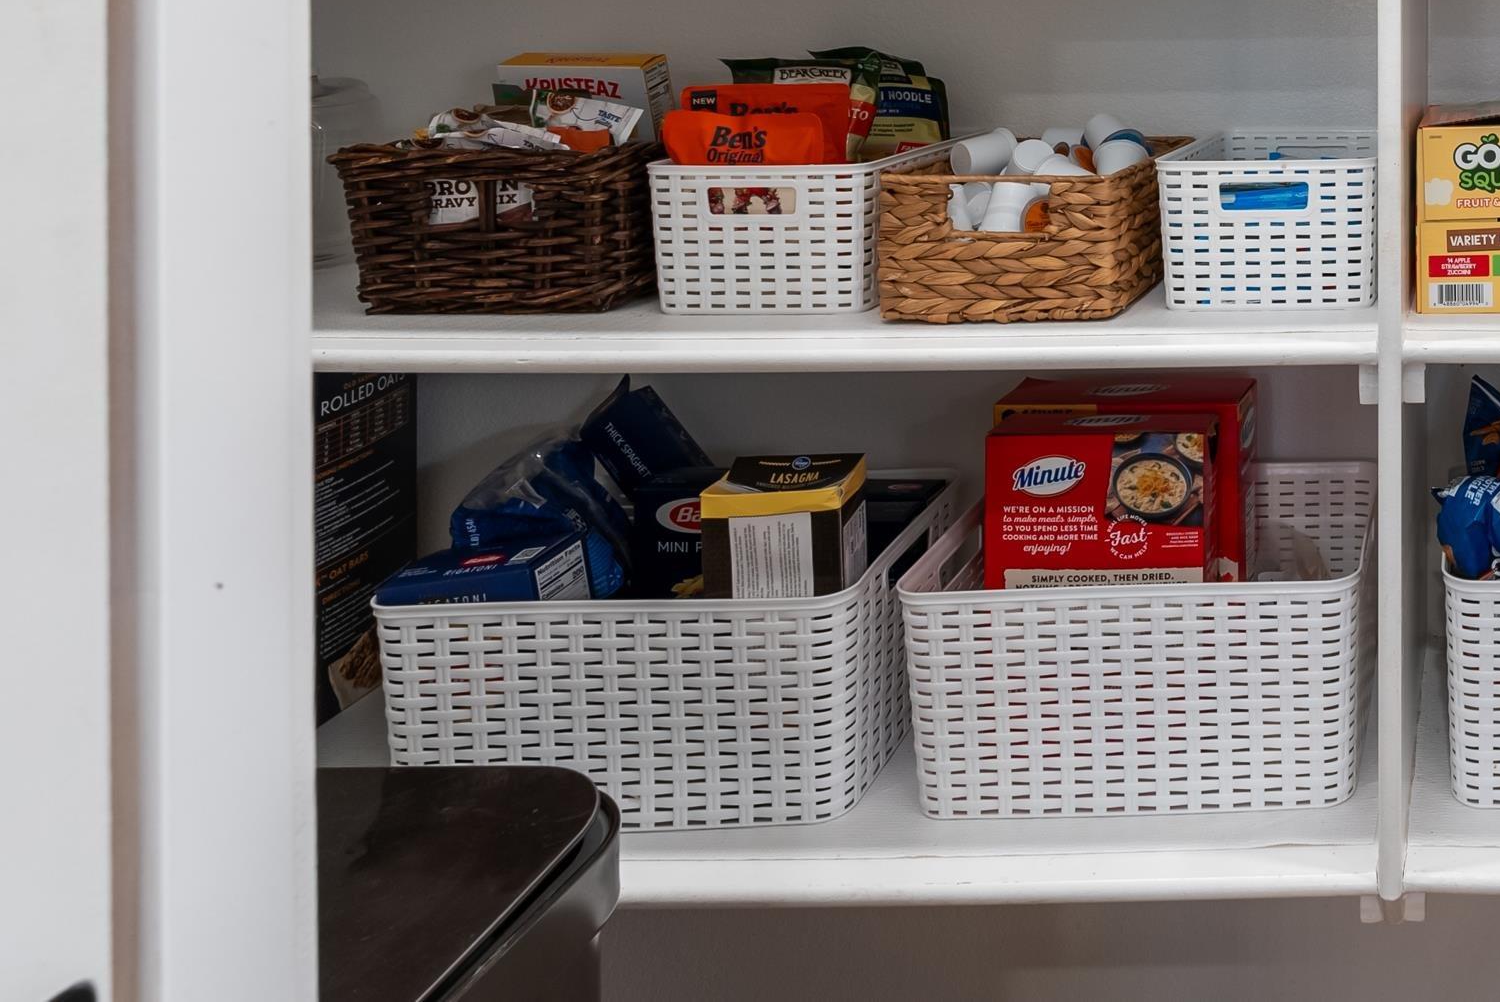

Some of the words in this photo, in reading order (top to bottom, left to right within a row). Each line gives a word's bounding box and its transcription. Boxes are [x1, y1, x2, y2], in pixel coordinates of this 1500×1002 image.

[779, 68, 810, 80] BEAR
[809, 68, 848, 79] CREEK
[524, 77, 624, 99] KRUSTEAZ
[692, 96, 716, 105] NEW
[888, 90, 932, 104] NOODLE
[597, 109, 622, 123] TASTE
[708, 126, 768, 149] Ben's
[706, 149, 764, 165] Original
[433, 196, 477, 208] RAVY
[1456, 198, 1491, 208] FRUIT
[1450, 234, 1496, 247] VARIETY
[320, 379, 375, 417] ROLLED
[604, 421, 624, 446] THICK
[770, 471, 820, 485] LASAGNA
[1013, 460, 1086, 490] Minute
[1488, 481, 1500, 495] TRY
[1002, 505, 1031, 514] WE'RE
[1032, 506, 1047, 514] ON
[1048, 506, 1055, 514] A
[1056, 505, 1094, 513] MISSION
[1003, 515, 1012, 523] to
[1013, 514, 1037, 523] make
[1038, 514, 1064, 523] meals
[1066, 514, 1098, 526] simple,
[1117, 514, 1129, 522] LIFE
[1130, 513, 1148, 527] MOVES
[1002, 524, 1013, 532] SO
[1014, 524, 1031, 532] YOU
[1033, 524, 1058, 532] SPEND
[1060, 524, 1078, 532] LESS
[1080, 524, 1098, 532] TIME
[1002, 533, 1037, 541] COOKING
[1038, 533, 1055, 541] AND
[1056, 533, 1078, 541] MORE
[1110, 527, 1148, 547] Fast
[657, 541, 689, 554] MINI
[1023, 541, 1071, 555] enjoying!
[443, 564, 498, 576] RIGATONI
[1031, 575, 1065, 583] SIMPLY
[1067, 574, 1110, 584] COOKED,
[1113, 573, 1139, 581] THEN
[1142, 572, 1175, 581] DRIED.
